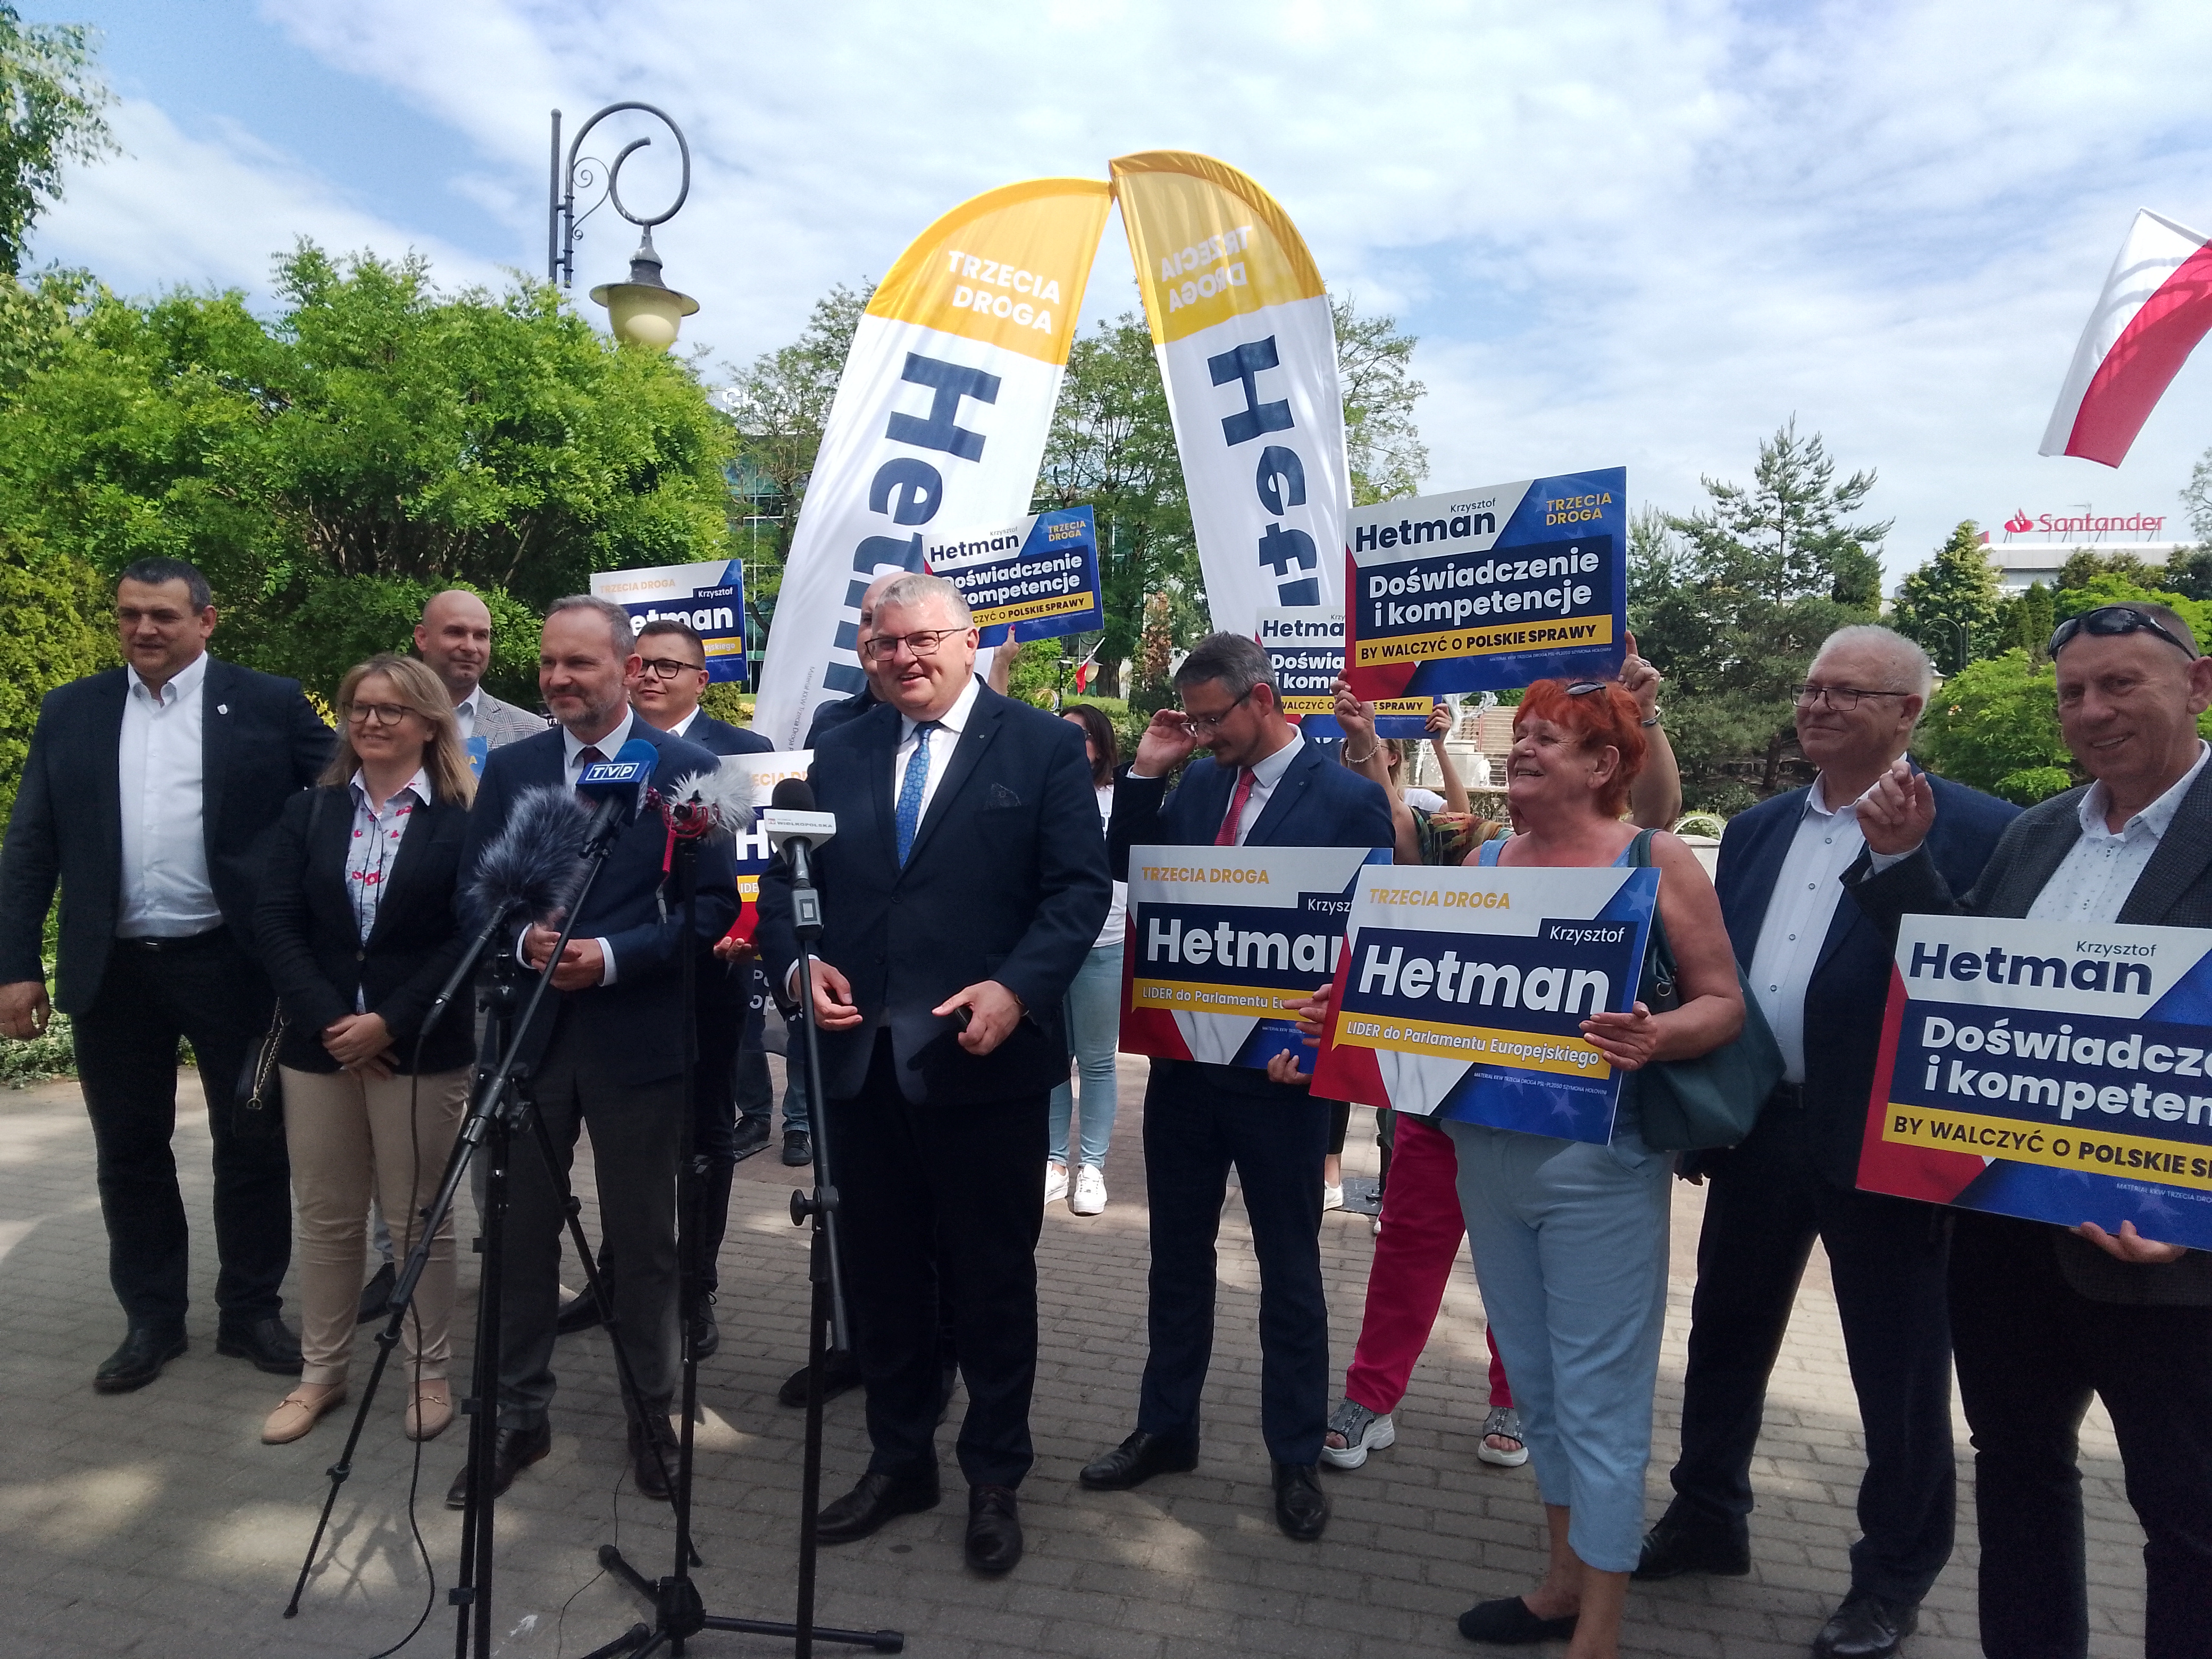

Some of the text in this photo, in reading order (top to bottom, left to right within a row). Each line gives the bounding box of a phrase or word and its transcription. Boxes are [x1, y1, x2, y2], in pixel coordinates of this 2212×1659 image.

[948, 250, 1060, 305] TRZECIA
[952, 284, 1052, 334] DROGA
[1450, 497, 1496, 514] Krzysztof
[1546, 492, 1612, 512] TRZECIA
[1048, 521, 1086, 533] TRZECIA
[1546, 508, 1603, 526] DROGA
[2039, 512, 2166, 532] Santander
[990, 526, 1018, 537] Krzysztof
[1049, 530, 1082, 542] DROGA
[1355, 511, 1496, 553] Hetman
[930, 534, 1019, 563] Hetman
[1369, 547, 1600, 599] Doświadczenie
[599, 579, 676, 594] TRZECIA DROGA
[698, 587, 733, 599] Krzysztof
[1008, 605, 1044, 618] POLSKIE
[1045, 597, 1085, 612] SPRAWY
[1375, 579, 1593, 627] i kompetencje
[1262, 619, 1345, 637] Hetma
[1361, 624, 1597, 660] BY WALCZYĆ O POLSKIE SPRAWY
[1379, 702, 1423, 710] SPRAWY
[788, 727, 799, 746] Droga
[592, 765, 634, 778] TVP
[1142, 866, 1269, 884] TRZECIA DROGA
[1308, 898, 1353, 916] Krzysz
[1369, 888, 1510, 910] TRZECIA DROGA
[1549, 925, 1626, 945] Krzysztof
[2076, 940, 2157, 957] Krzysztof
[1909, 941, 2154, 996] Hetman
[1358, 944, 1610, 1016] Hetman
[1143, 987, 1172, 1000] LIDER
[1176, 988, 1192, 1002] do
[1194, 990, 1268, 1009] Parlamentu
[1346, 1021, 1599, 1068] LIDER do Parlamentu Europejskiego
[1922, 1016, 2212, 1077] Doświadcz
[1563, 1084, 1585, 1092] SZYMONA
[1924, 1054, 2212, 1127] i kompeten
[1893, 1115, 1923, 1136] BY
[1930, 1120, 2045, 1153] WALCZYĆ
[2052, 1138, 2071, 1157] O
[2078, 1141, 2186, 1175] POLSKIE
[2167, 1191, 2195, 1200] TRZECIA
